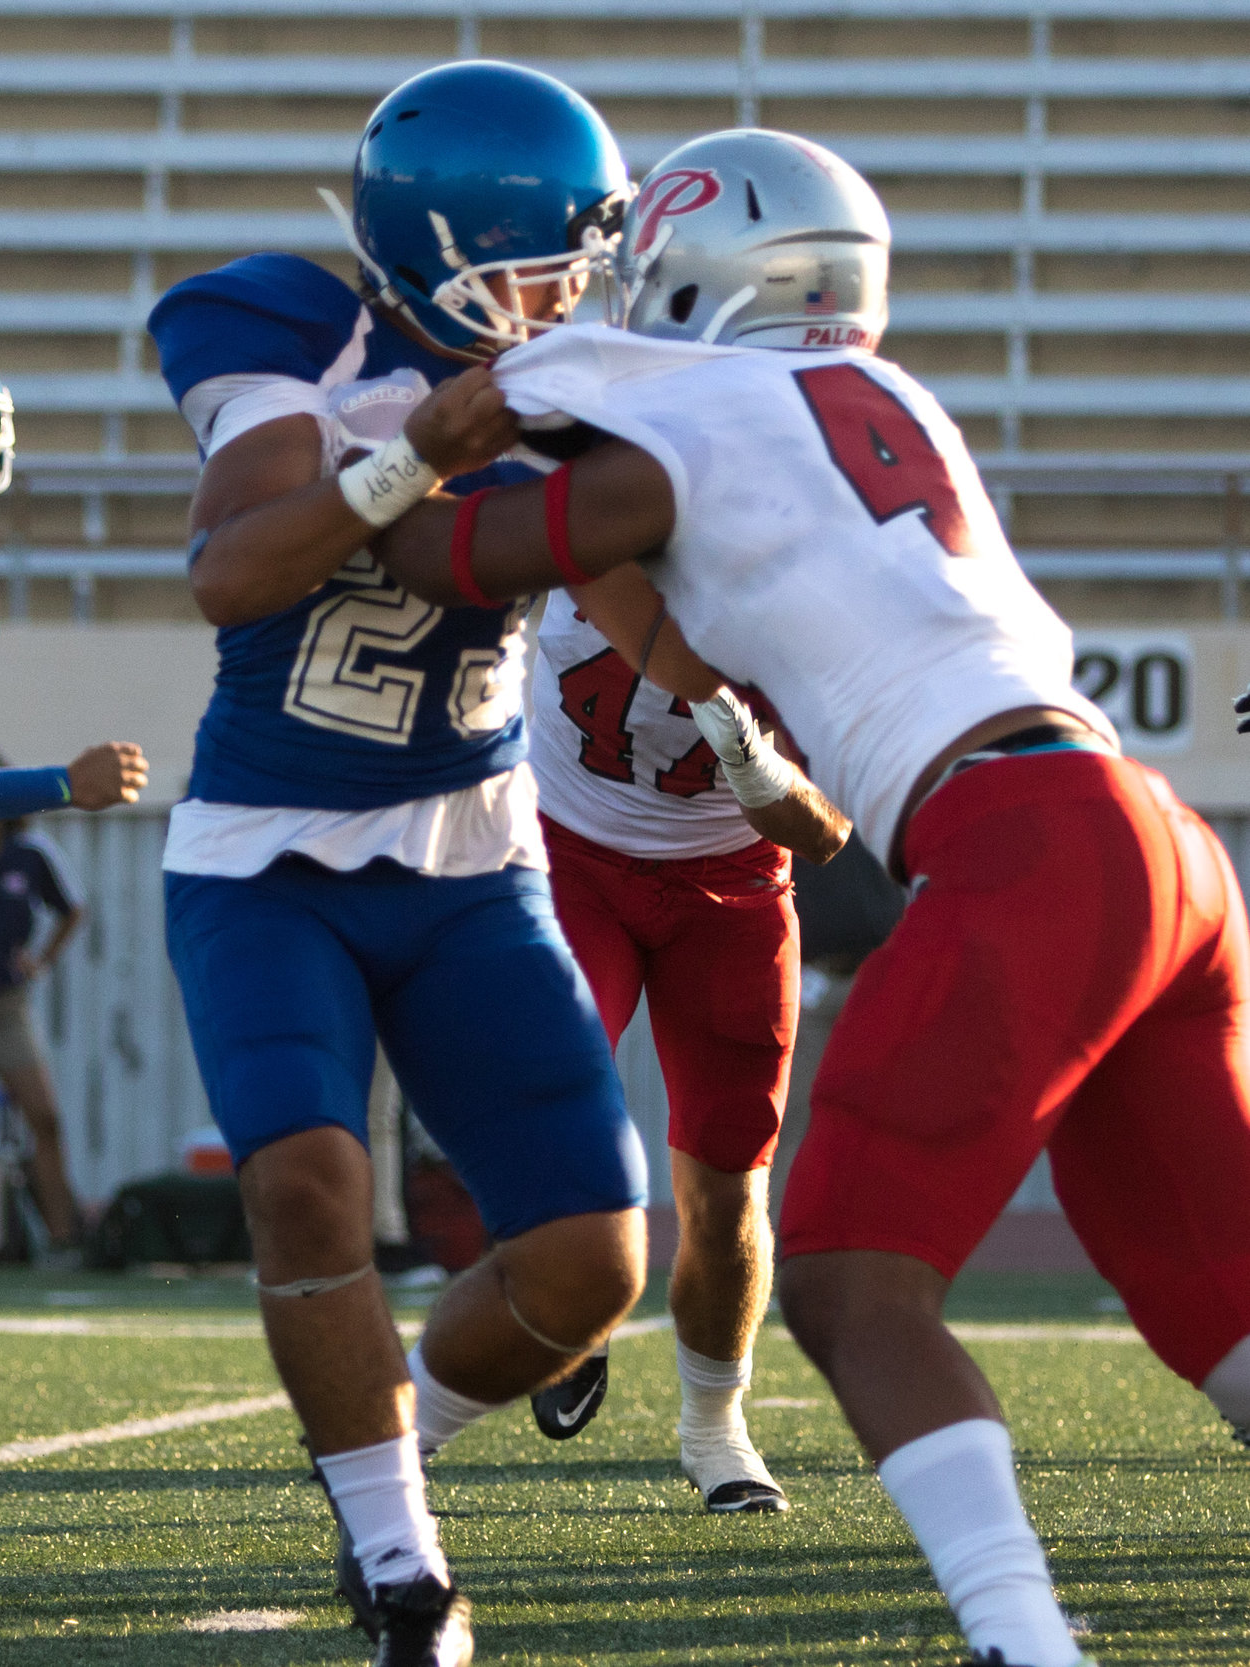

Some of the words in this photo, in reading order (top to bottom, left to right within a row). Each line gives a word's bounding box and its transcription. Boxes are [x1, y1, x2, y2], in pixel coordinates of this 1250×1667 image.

[634, 169, 721, 256] P
[364, 455, 419, 502] PLAY
[791, 362, 982, 557] 4
